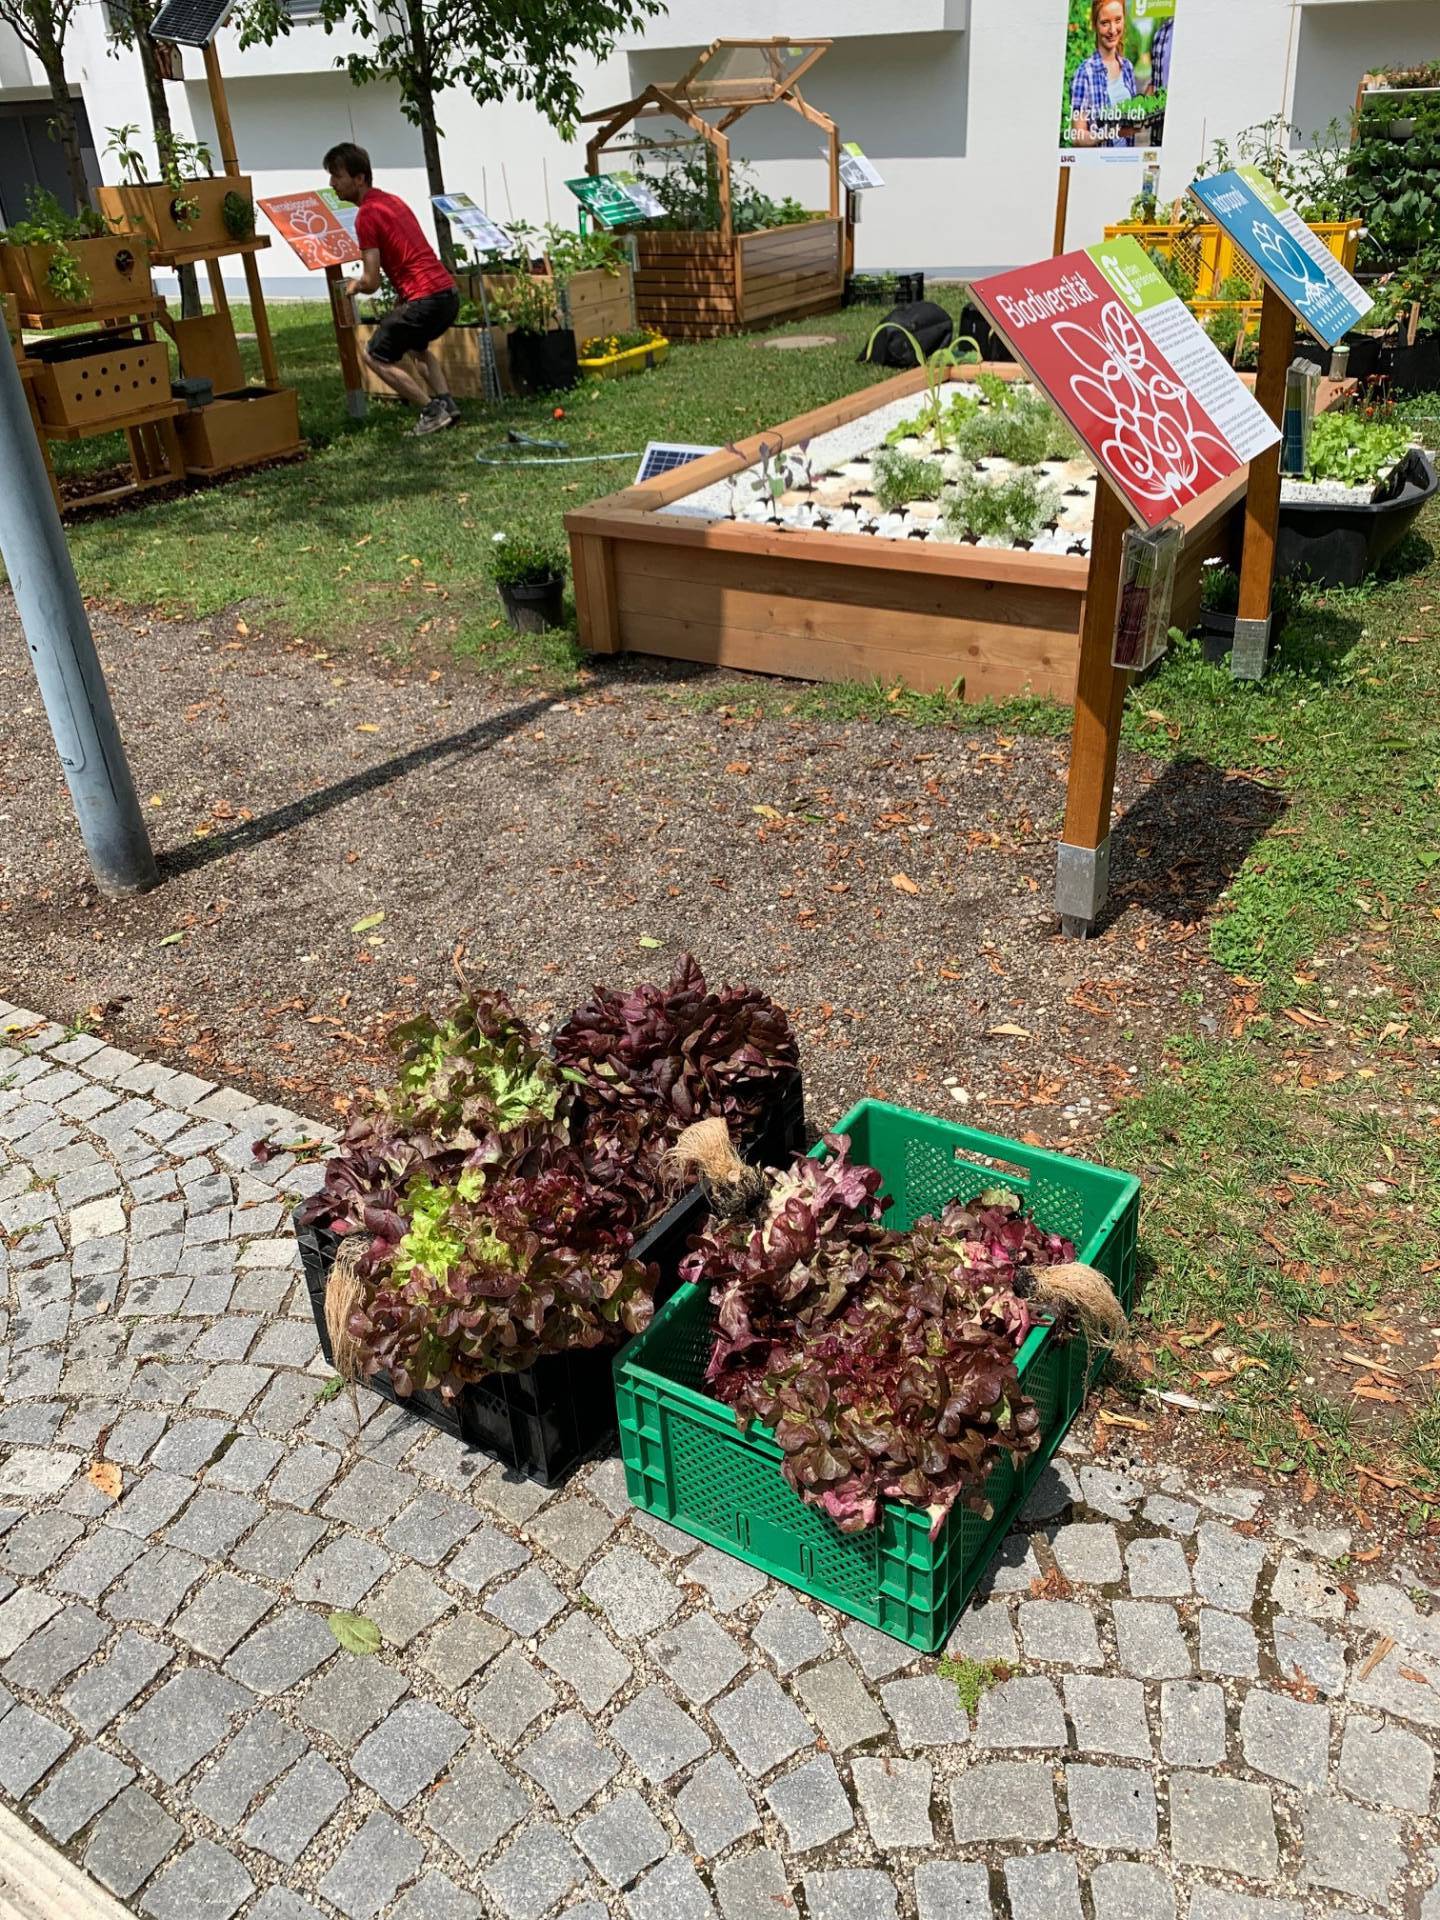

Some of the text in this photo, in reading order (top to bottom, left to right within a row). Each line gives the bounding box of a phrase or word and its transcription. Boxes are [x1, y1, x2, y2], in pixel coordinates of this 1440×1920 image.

[1065, 104, 1097, 122] Jetzt
[1127, 104, 1145, 120] ich
[1063, 123, 1121, 141] den Salat
[995, 271, 1099, 329] Biodiversität
